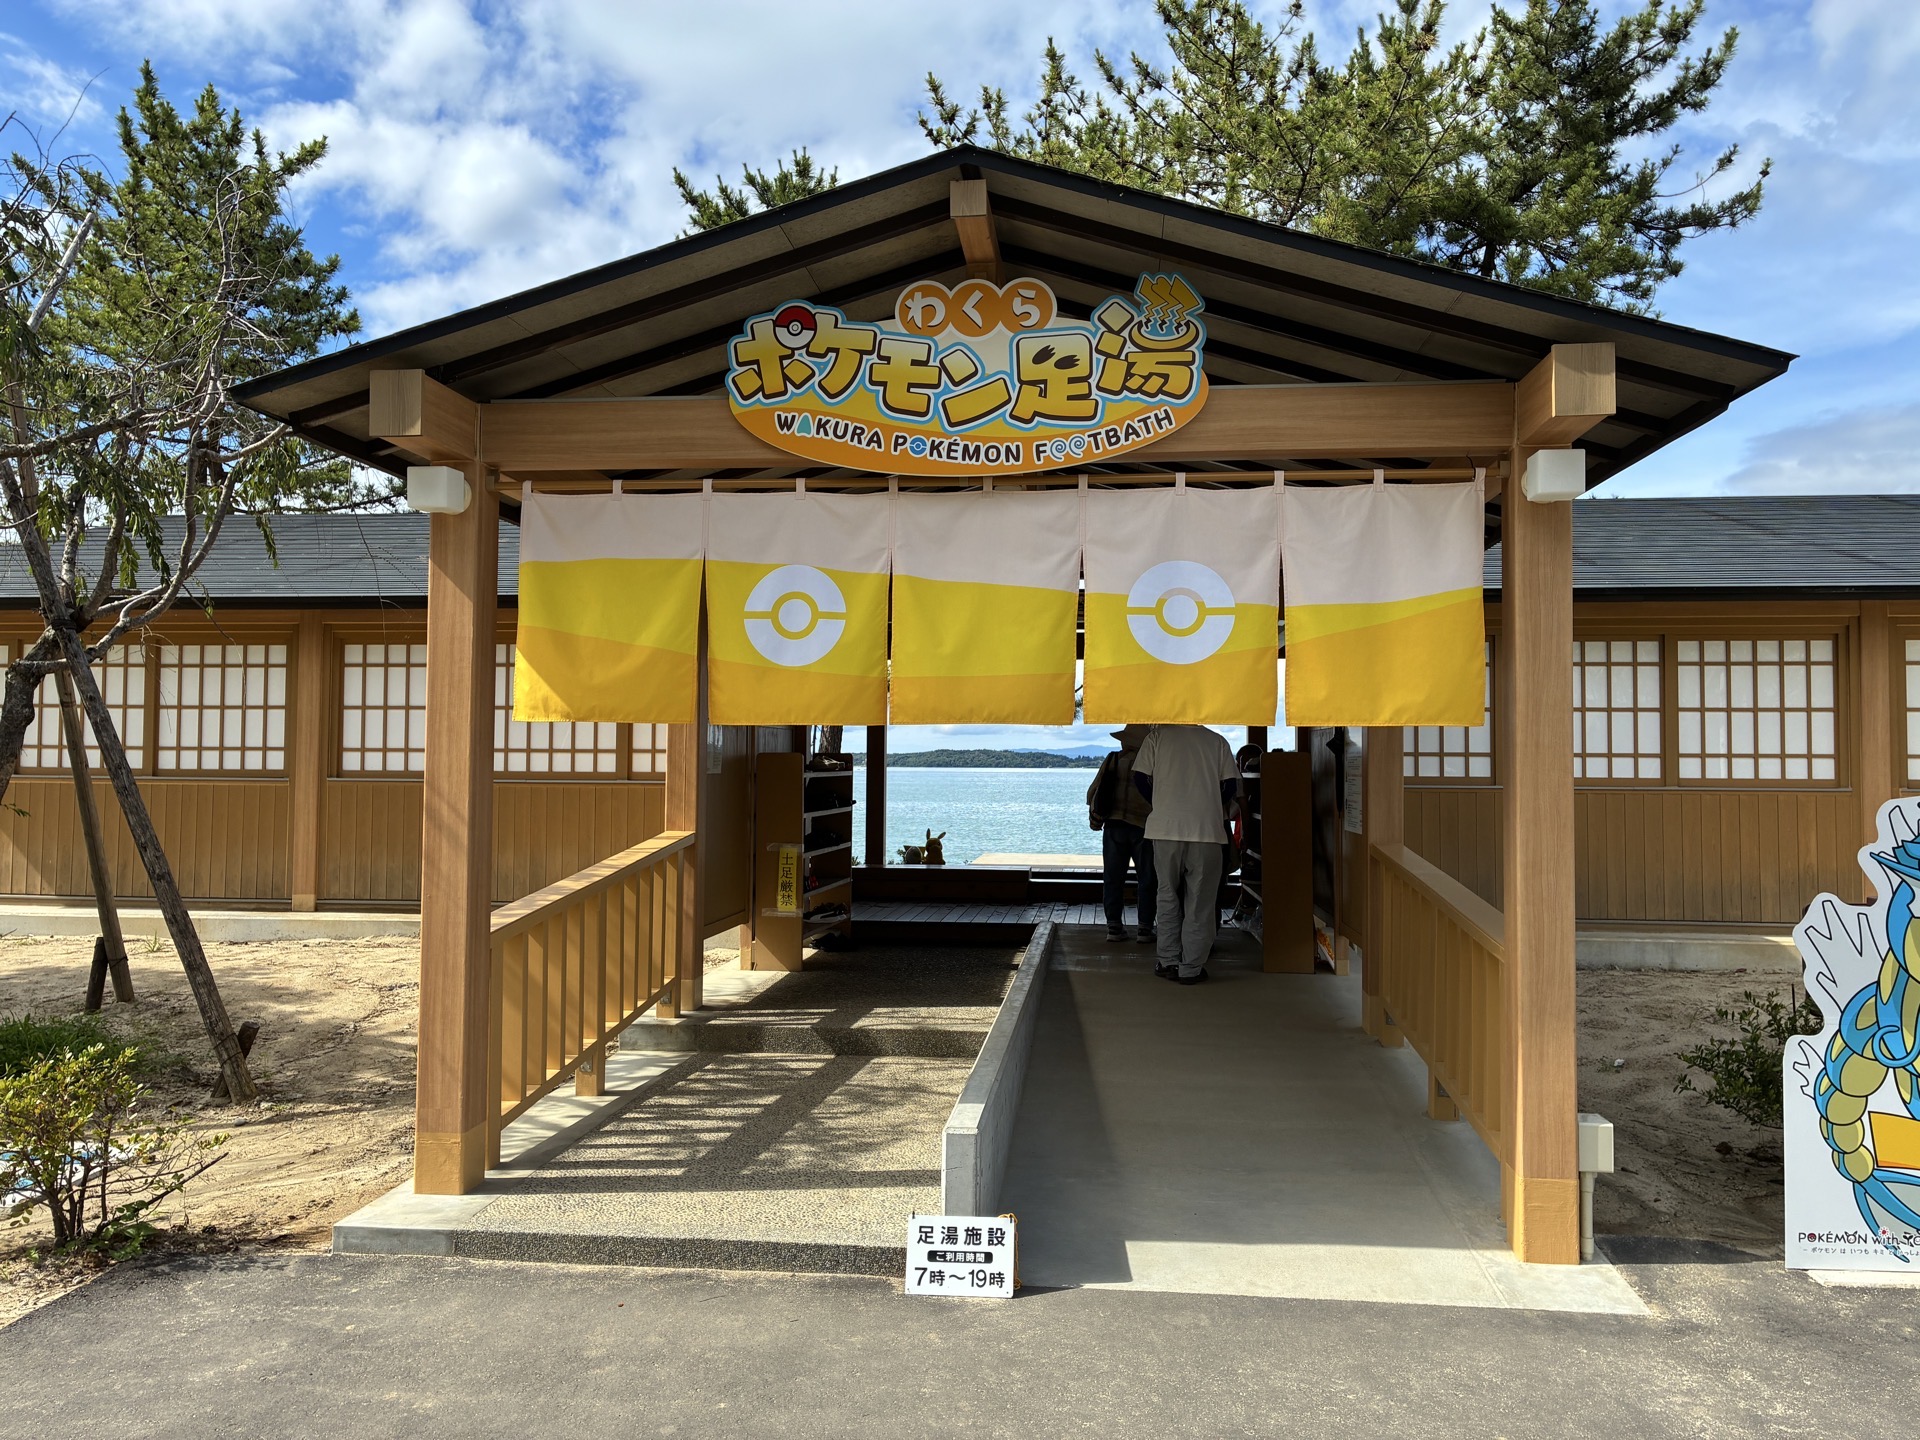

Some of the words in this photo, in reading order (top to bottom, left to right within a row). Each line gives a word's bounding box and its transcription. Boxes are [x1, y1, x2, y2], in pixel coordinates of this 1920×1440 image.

[905, 288, 1041, 329] わくら
[733, 273, 1204, 428] ポケモン足湯
[775, 412, 884, 450] WAKURA
[893, 432, 1021, 463] POKÉMON
[780, 852, 794, 907] 土足厳禁
[917, 1225, 1006, 1247] 足湯施設
[1798, 1230, 1868, 1245] POKÉMON
[1871, 1228, 1900, 1245] with
[936, 1251, 985, 1263] ご利用時間
